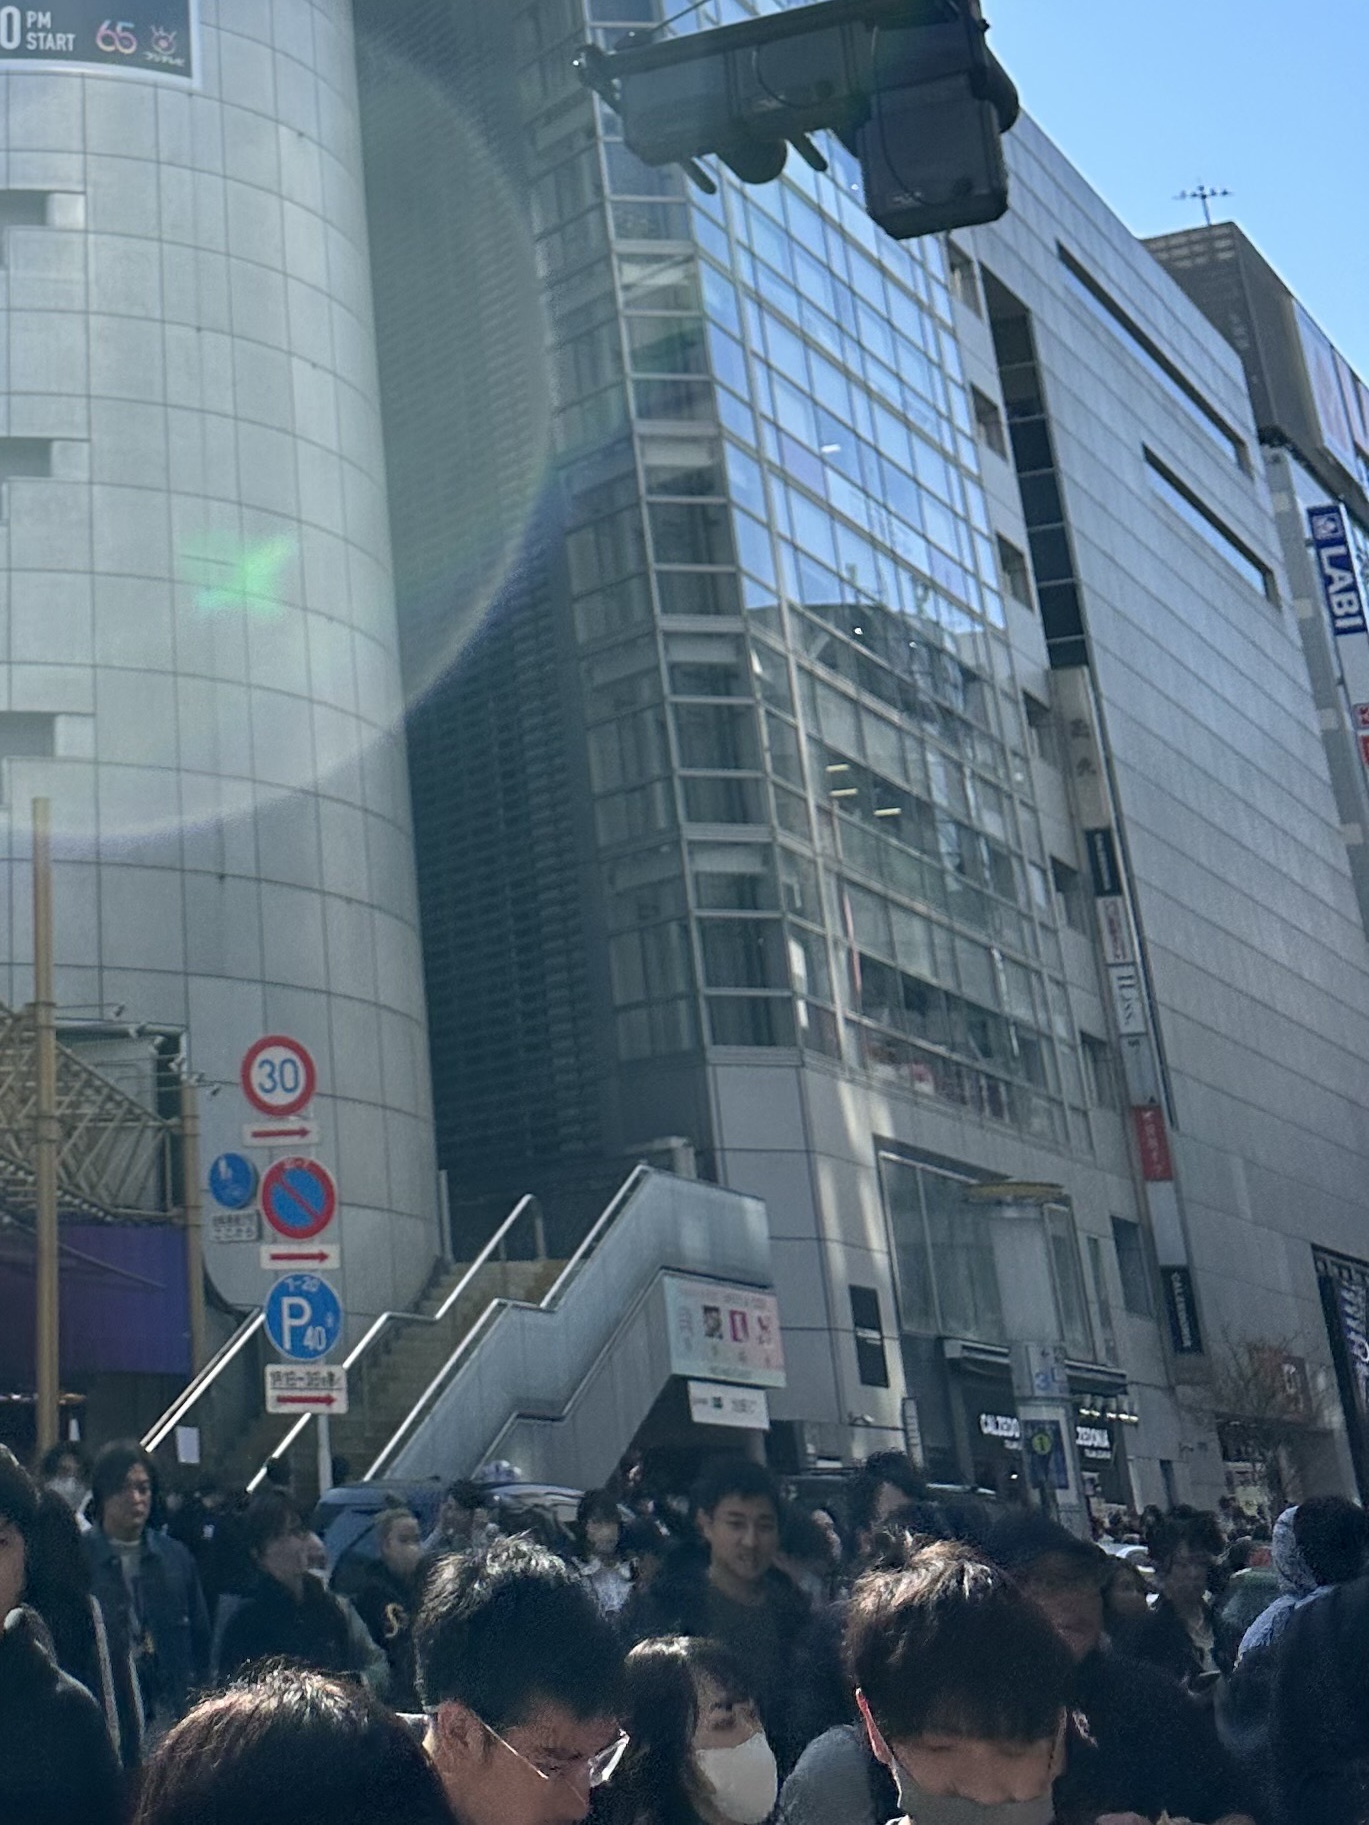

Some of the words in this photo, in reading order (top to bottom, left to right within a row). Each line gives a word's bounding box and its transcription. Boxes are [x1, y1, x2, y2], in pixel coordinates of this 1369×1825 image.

[26, 11, 51, 28] PM
[96, 19, 137, 54] 65
[26, 32, 76, 52] START
[1319, 545, 1363, 628] LABI
[257, 1057, 300, 1095] 30
[282, 1296, 312, 1350] P
[303, 1326, 327, 1351] 40
